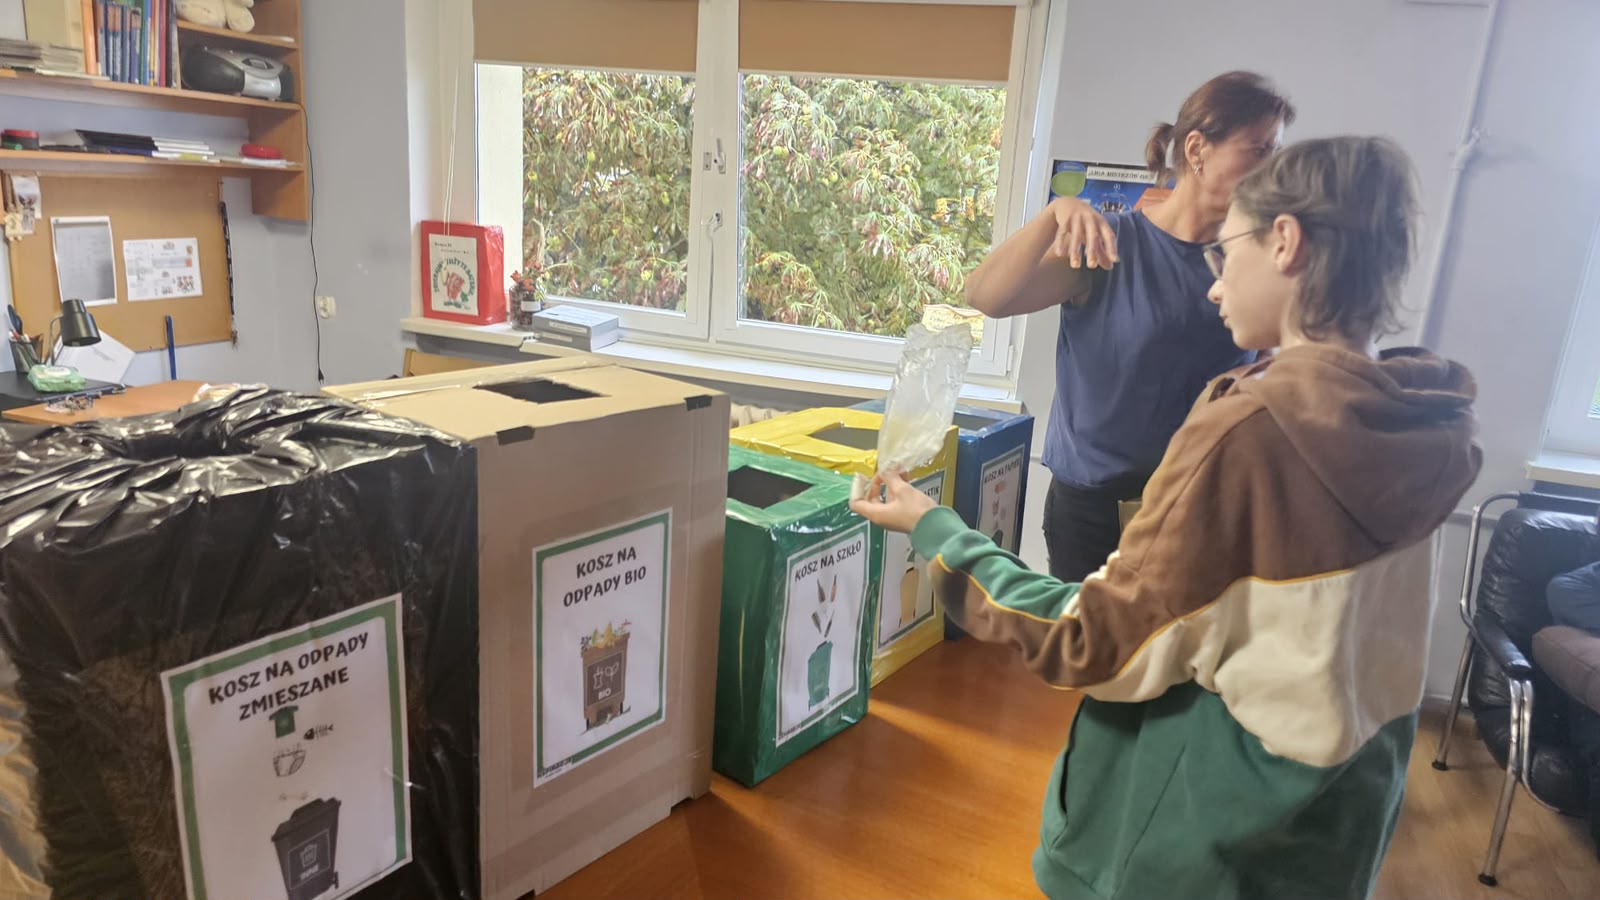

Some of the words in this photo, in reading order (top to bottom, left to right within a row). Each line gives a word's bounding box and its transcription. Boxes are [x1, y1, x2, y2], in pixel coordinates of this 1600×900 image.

[983, 470, 997, 484] KOSZ
[576, 553, 613, 579] KOSZ
[617, 546, 637, 564] NA
[795, 561, 818, 582] KOSZ
[820, 554, 834, 569] NA
[836, 540, 862, 562] SZKŁO
[563, 574, 621, 607] ODPADY
[624, 565, 646, 585] BIO
[208, 671, 261, 705] KOSZ
[265, 660, 294, 682] NA
[297, 632, 369, 671] ODPADY
[239, 666, 350, 721] ZMIESZANE
[598, 687, 611, 700] BIO
